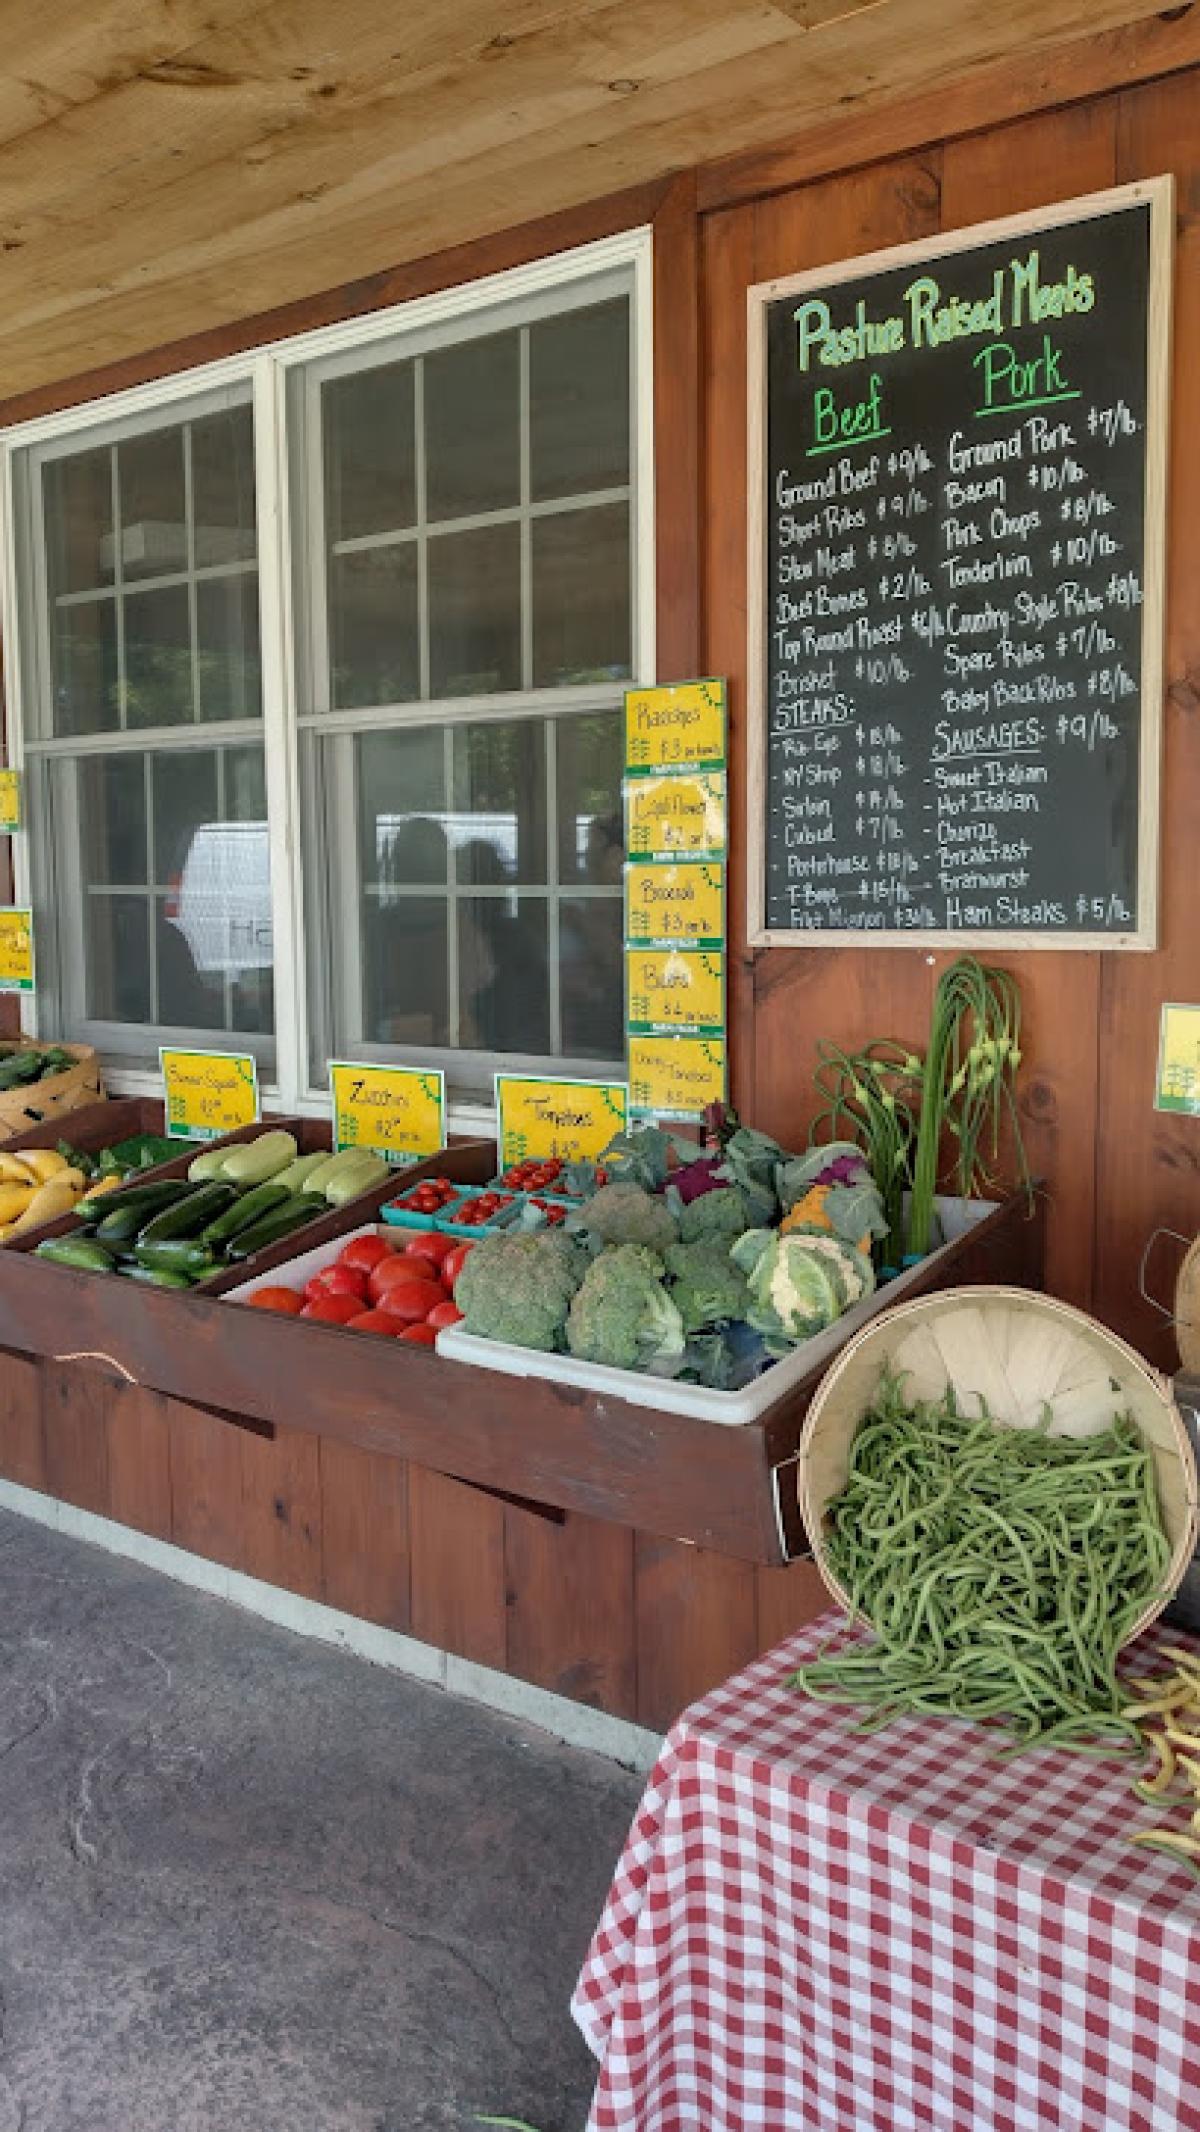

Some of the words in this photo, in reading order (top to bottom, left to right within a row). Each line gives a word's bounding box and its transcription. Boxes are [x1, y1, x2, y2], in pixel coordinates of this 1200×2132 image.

[795, 300, 906, 371] Pasture
[903, 270, 1004, 347] Raised
[1011, 250, 1094, 327] Meats
[973, 335, 1068, 405] Pork
[815, 374, 882, 441] Beef
[949, 431, 1021, 473] Ground
[1024, 416, 1077, 453] Pork
[776, 467, 836, 509] Ground
[838, 455, 879, 494] Beef
[944, 476, 1006, 509] Bacon
[779, 514, 821, 547] Short
[823, 505, 866, 538] Ribs
[940, 517, 983, 551] Pork
[990, 508, 1041, 541] Chops
[779, 555, 812, 582] Stew
[817, 544, 856, 579] Meat
[939, 553, 1033, 588] Tenderloin
[776, 590, 813, 624] Beef
[815, 585, 869, 615] Bones
[1056, 581, 1103, 617] Ribs
[773, 628, 800, 664] Top
[802, 623, 854, 656] Round
[856, 614, 903, 650] Roast
[774, 659, 836, 697] Brisket
[944, 643, 996, 680] Spare
[997, 640, 1044, 668] Ribs
[941, 687, 988, 715] Baby
[992, 679, 1036, 708] Back
[1036, 673, 1077, 704] Ribs
[934, 767, 982, 788] Sweet
[983, 761, 1047, 786] Italian
[938, 794, 968, 818] Hot
[970, 788, 1040, 812] Italian
[936, 838, 1033, 868] Breakfast
[641, 878, 695, 904] Broccoli
[946, 897, 993, 931] Ham
[996, 896, 1068, 924] Steaks
[350, 1079, 410, 1111] Zucchini
[523, 1096, 594, 1130] Tomatoes
